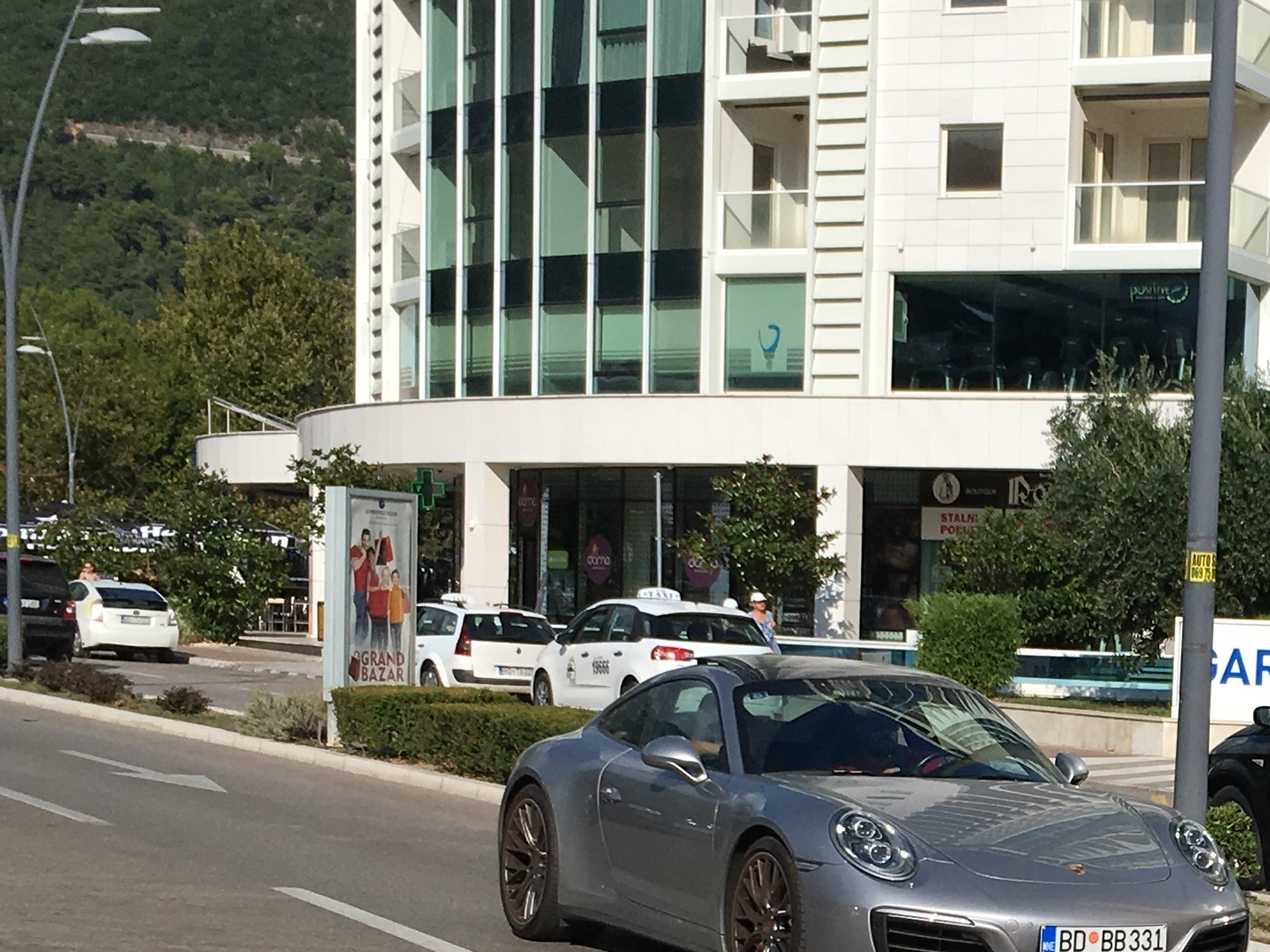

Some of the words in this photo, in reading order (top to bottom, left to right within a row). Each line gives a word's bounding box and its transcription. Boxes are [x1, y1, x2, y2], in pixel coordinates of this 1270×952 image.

[1192, 554, 1211, 567] AUTO
[648, 591, 673, 599] TAXI
[361, 650, 405, 667] GRAND
[361, 667, 405, 682] BAZAR
[1059, 929, 1087, 952] BD
